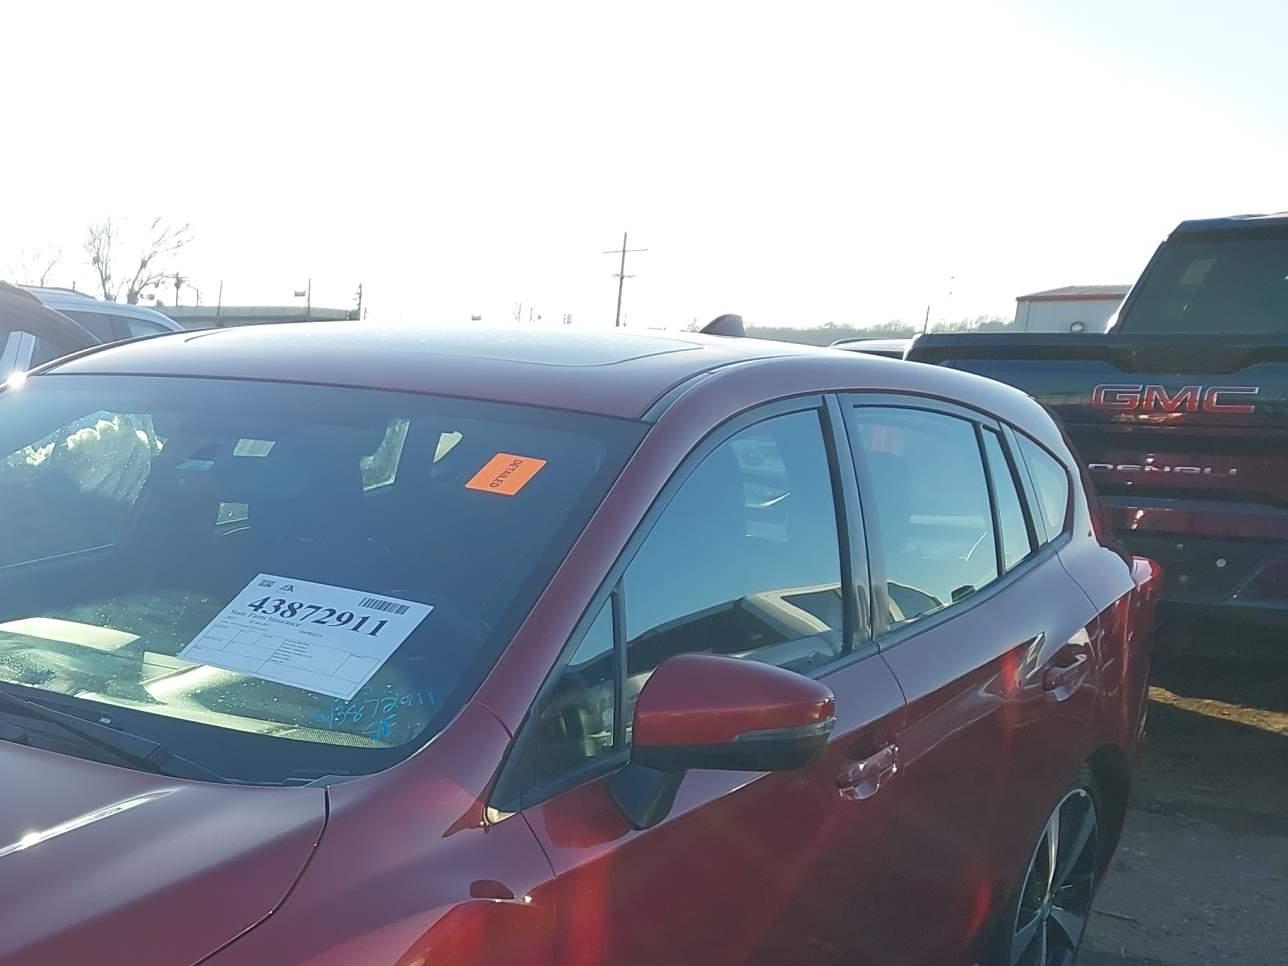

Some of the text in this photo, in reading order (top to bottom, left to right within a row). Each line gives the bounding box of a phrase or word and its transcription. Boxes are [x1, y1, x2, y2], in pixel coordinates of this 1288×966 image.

[1092, 383, 1260, 413] GMC
[489, 459, 524, 488] DETAILED
[247, 596, 390, 637] 43872911
